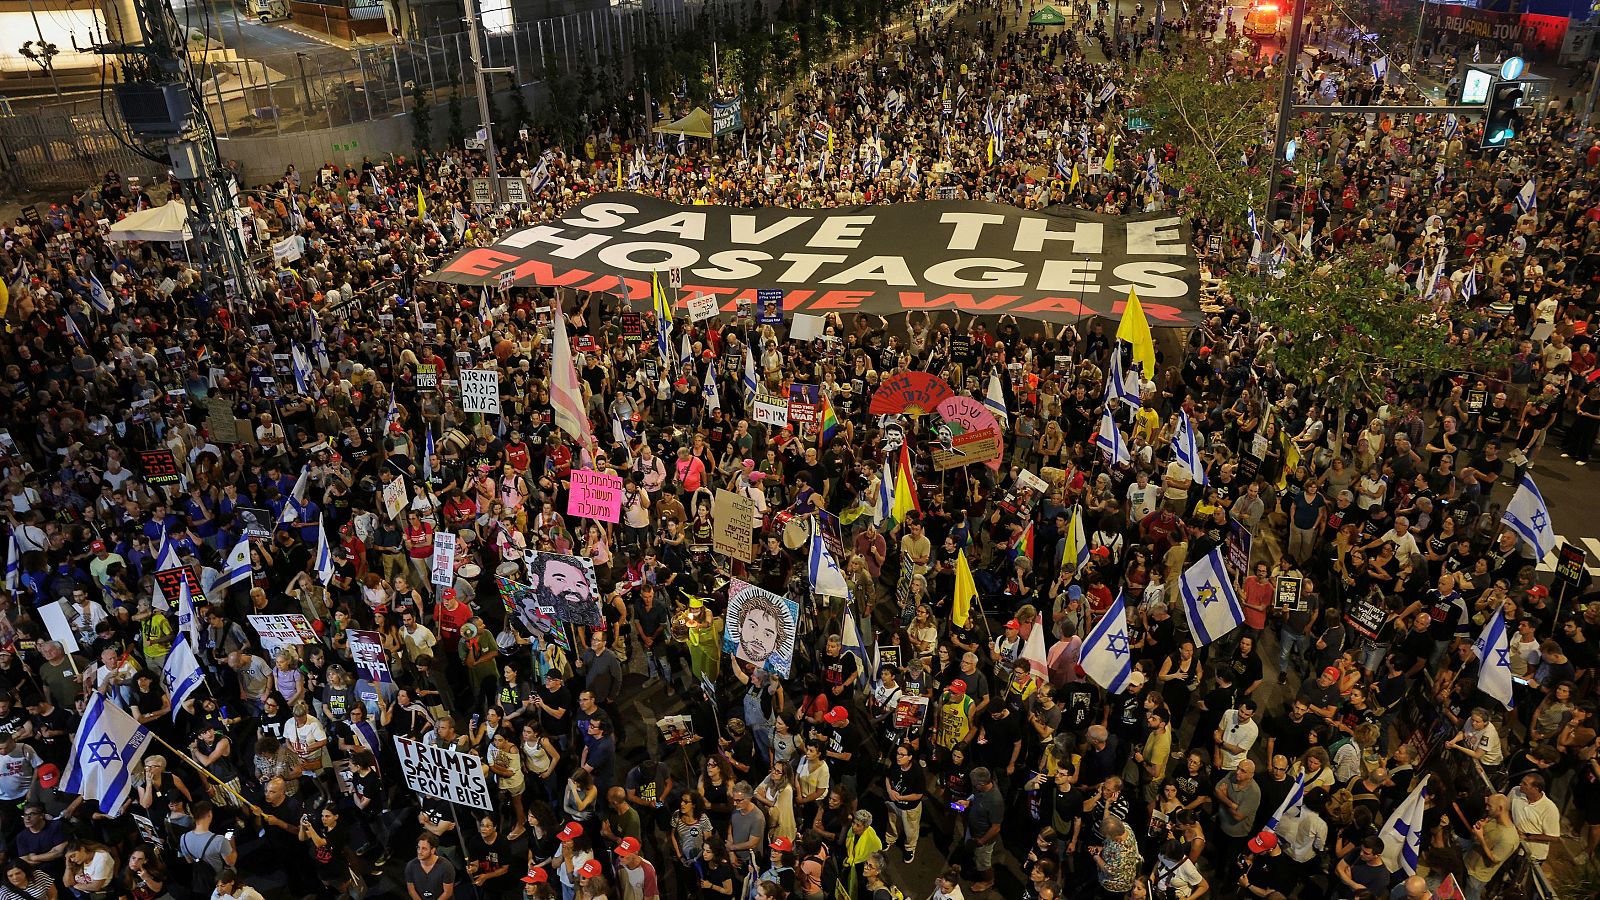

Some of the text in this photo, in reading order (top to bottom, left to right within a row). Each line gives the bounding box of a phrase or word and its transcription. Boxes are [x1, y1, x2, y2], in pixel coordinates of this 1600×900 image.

[1493, 24, 1537, 41] TOWR
[562, 203, 1188, 256] SAVE THE
[502, 224, 1190, 298] HOSTAGES
[671, 268, 681, 284] 58
[443, 247, 654, 301] END
[672, 284, 898, 313] THE
[898, 291, 1191, 324] WAR
[417, 378, 436, 387] LIVES!
[461, 370, 496, 382] ממשלה
[464, 382, 497, 395] בוגדת
[462, 394, 497, 410] בעמה
[946, 400, 982, 419] שלום
[755, 407, 786, 422] אין זמן
[790, 412, 814, 421] WAR
[142, 454, 173, 465] ביבי
[144, 464, 176, 474] בוגד
[572, 473, 622, 491] במלחמת נצח
[581, 484, 613, 502] תעשה לך
[577, 500, 611, 518] ממשלה
[740, 513, 751, 523] לא
[159, 571, 195, 586] בבי
[273, 615, 287, 623] הם
[350, 641, 382, 656] קטאר
[398, 737, 478, 776] TRUMP
[404, 758, 486, 794] SAVE US
[406, 774, 488, 809] FROM BIBI
